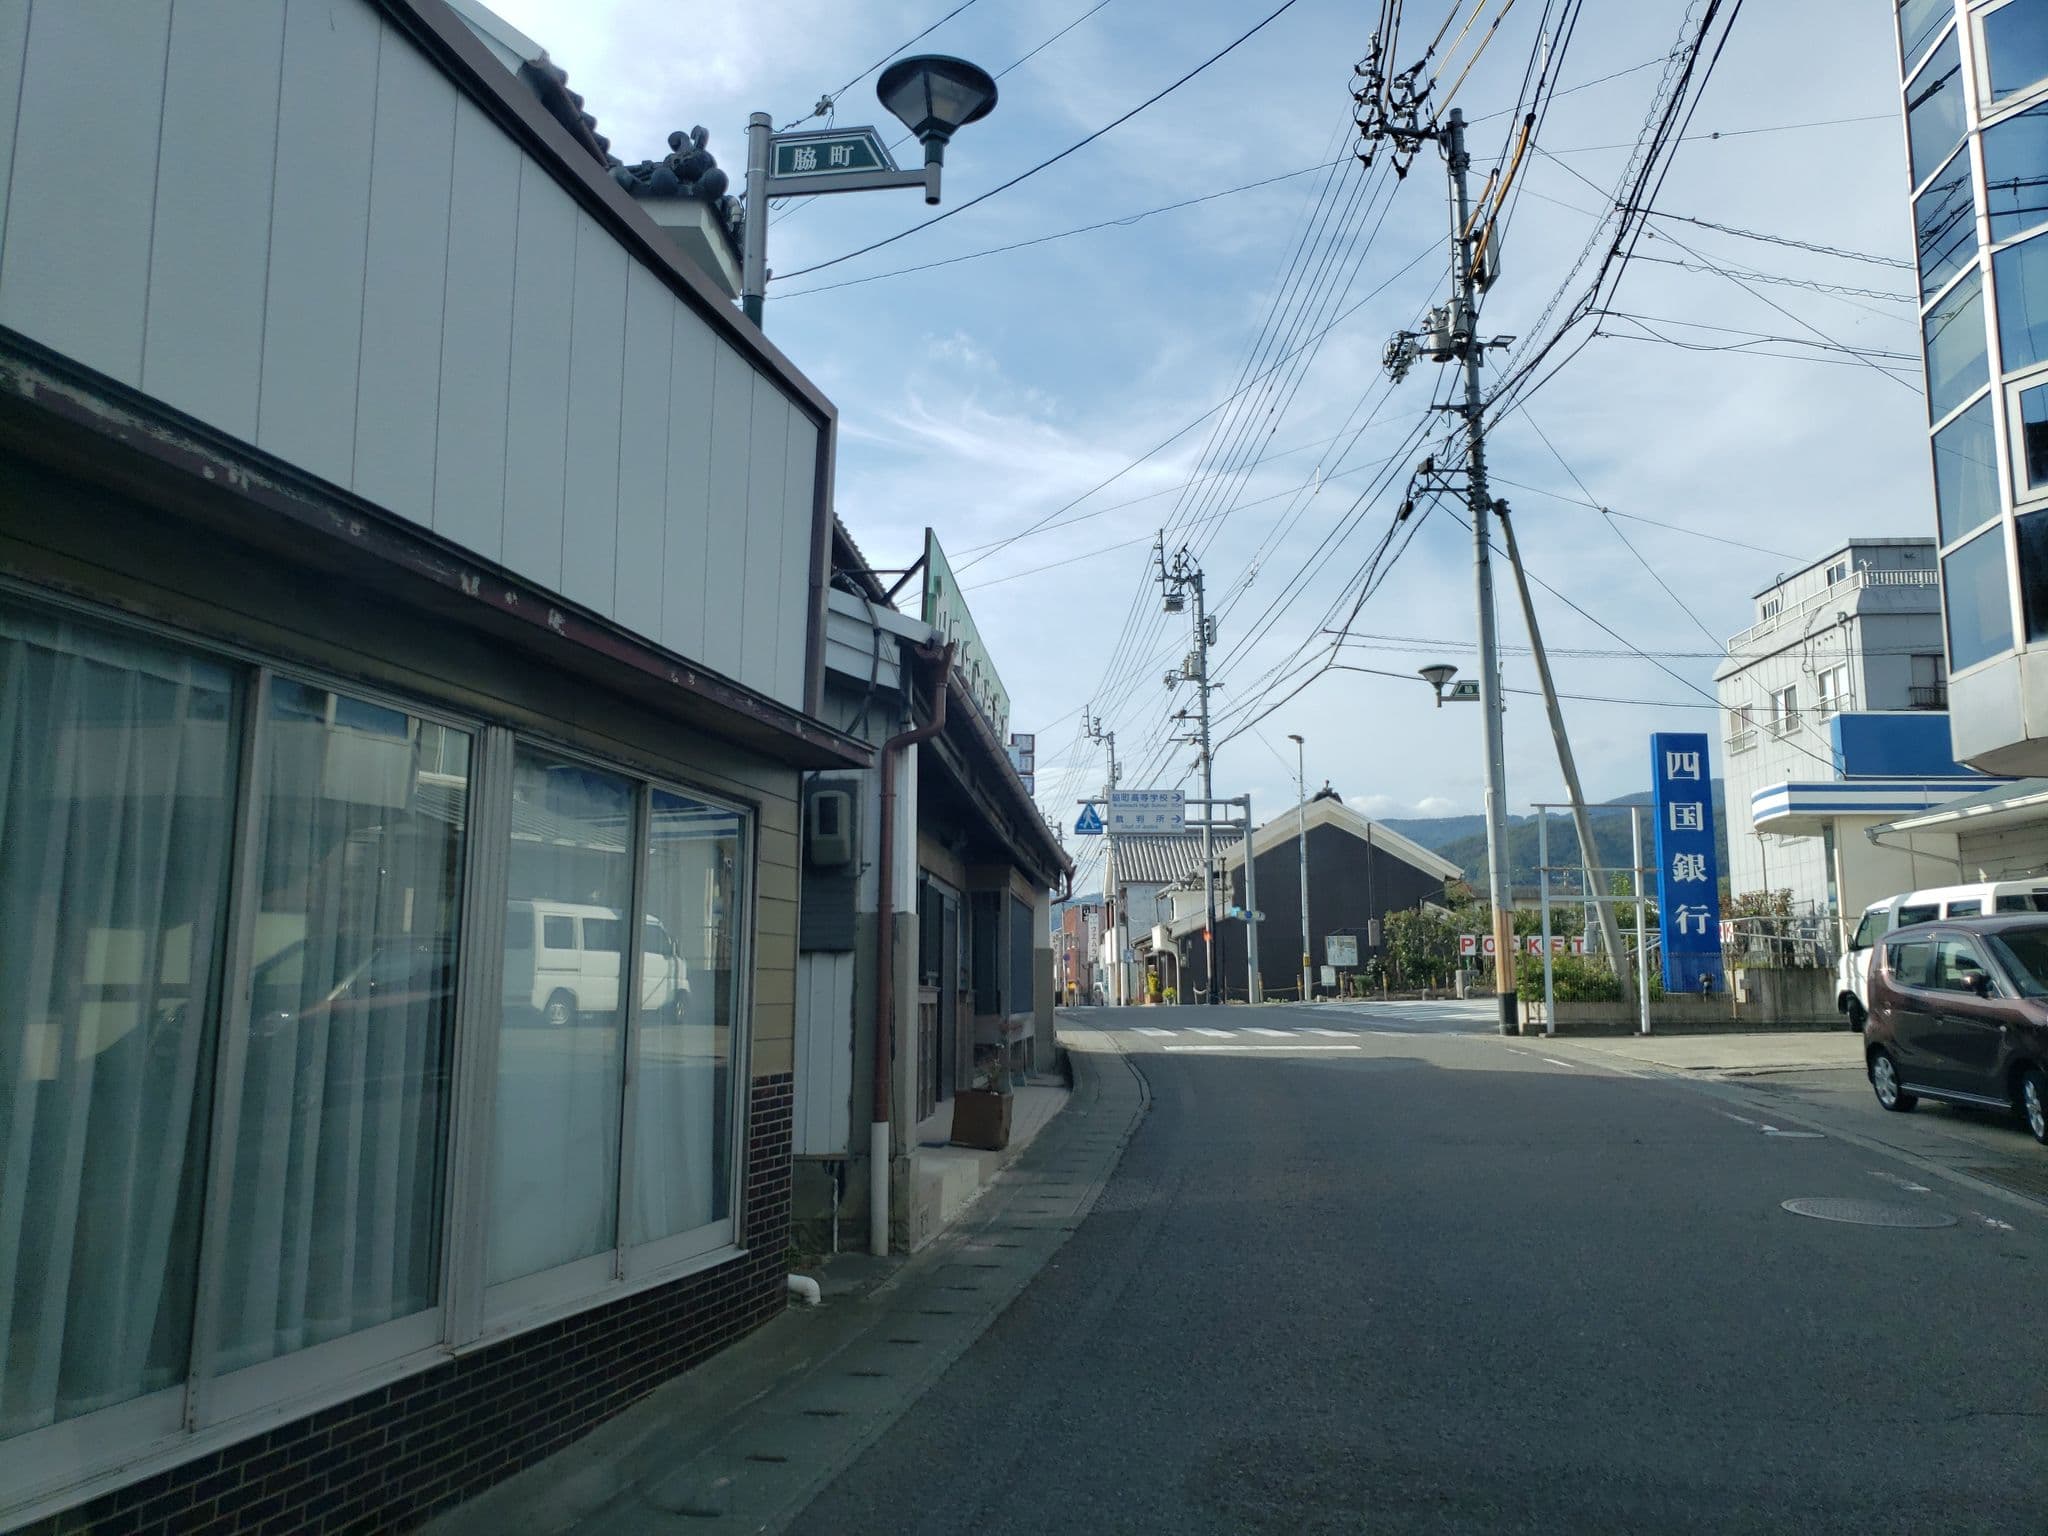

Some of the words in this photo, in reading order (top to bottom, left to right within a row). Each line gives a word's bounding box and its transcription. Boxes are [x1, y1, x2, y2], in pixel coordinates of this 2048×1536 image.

[792, 145, 854, 172] 脇町
[1665, 751, 1711, 935] 四国銀行
